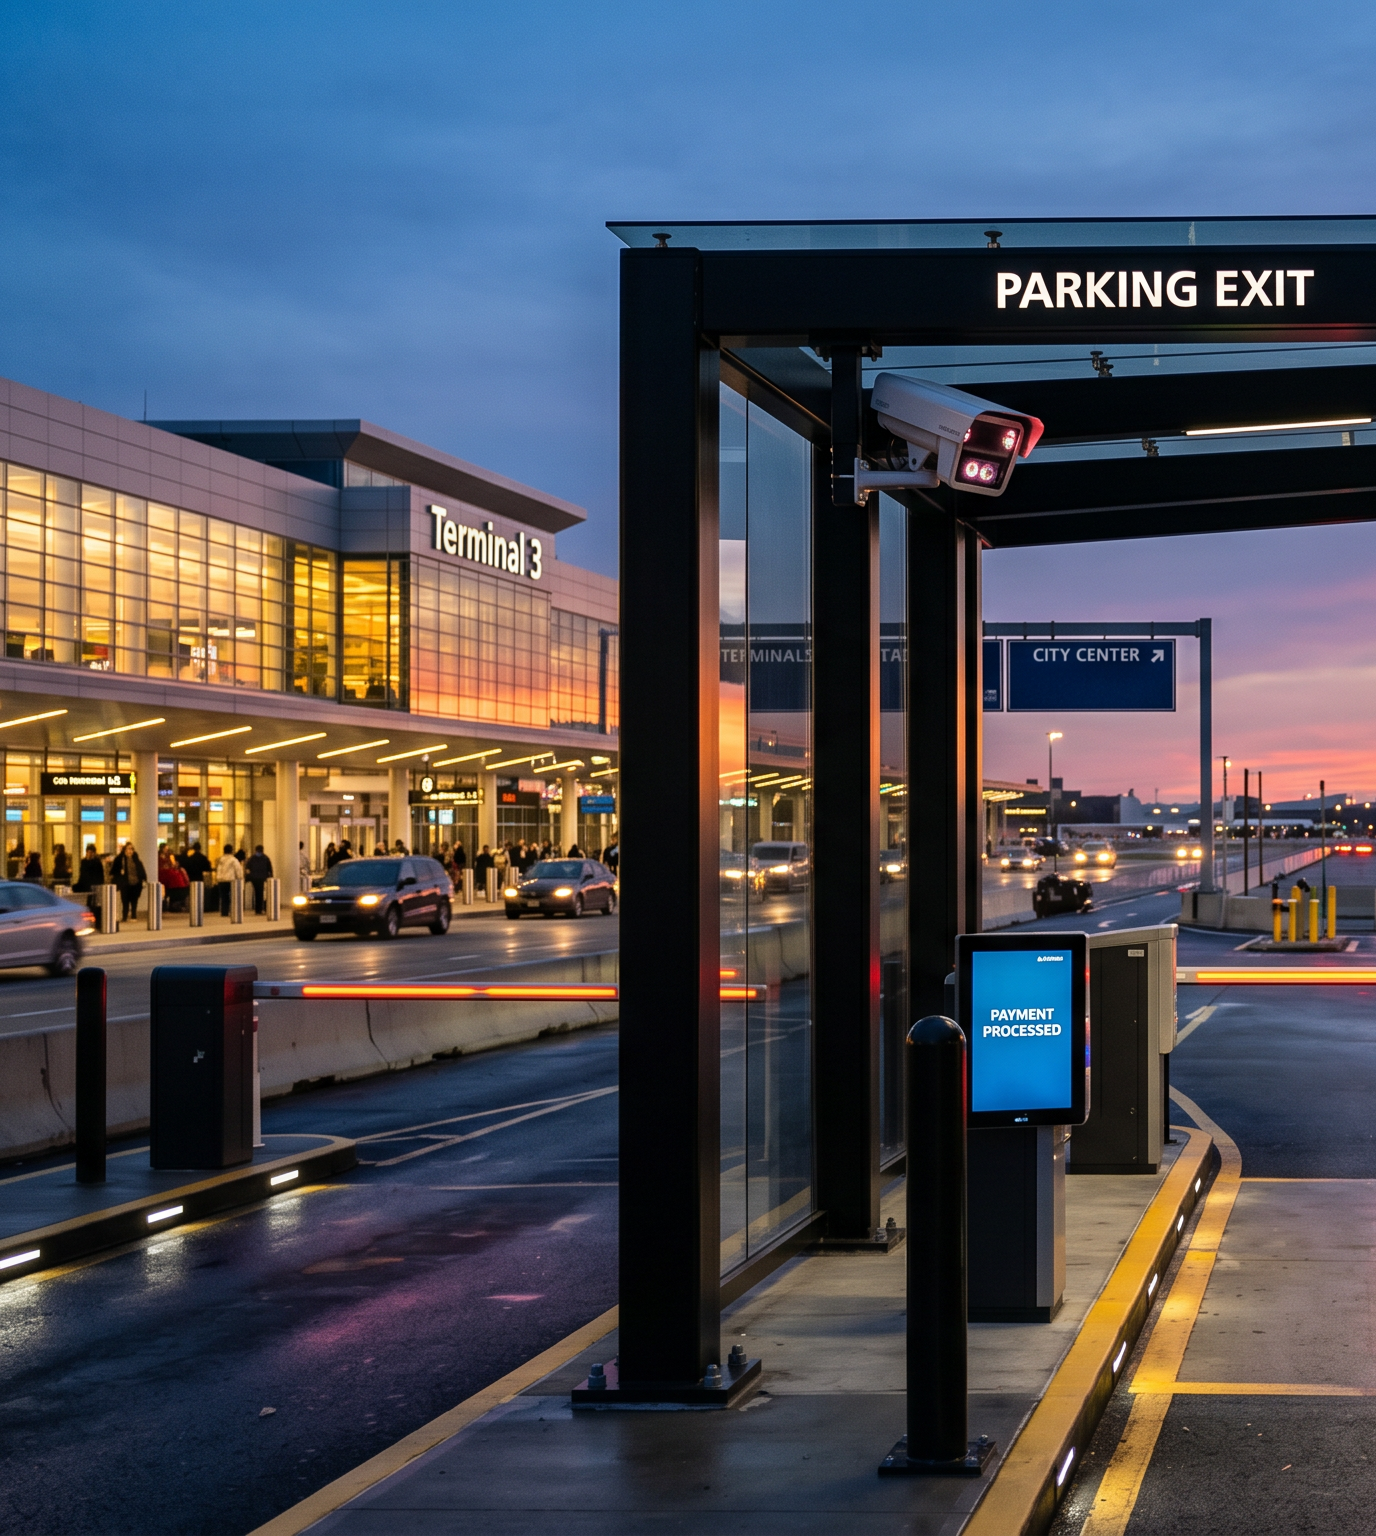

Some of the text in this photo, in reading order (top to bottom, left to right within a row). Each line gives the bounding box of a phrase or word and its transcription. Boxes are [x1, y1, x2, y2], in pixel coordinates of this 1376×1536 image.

[997, 269, 1316, 309] PARKING EXIT
[431, 504, 542, 580] Terminal 3
[1033, 648, 1140, 662] CITY CENTER
[991, 1007, 1054, 1021] PAYMENT
[983, 1023, 1061, 1037] PROCESSED
